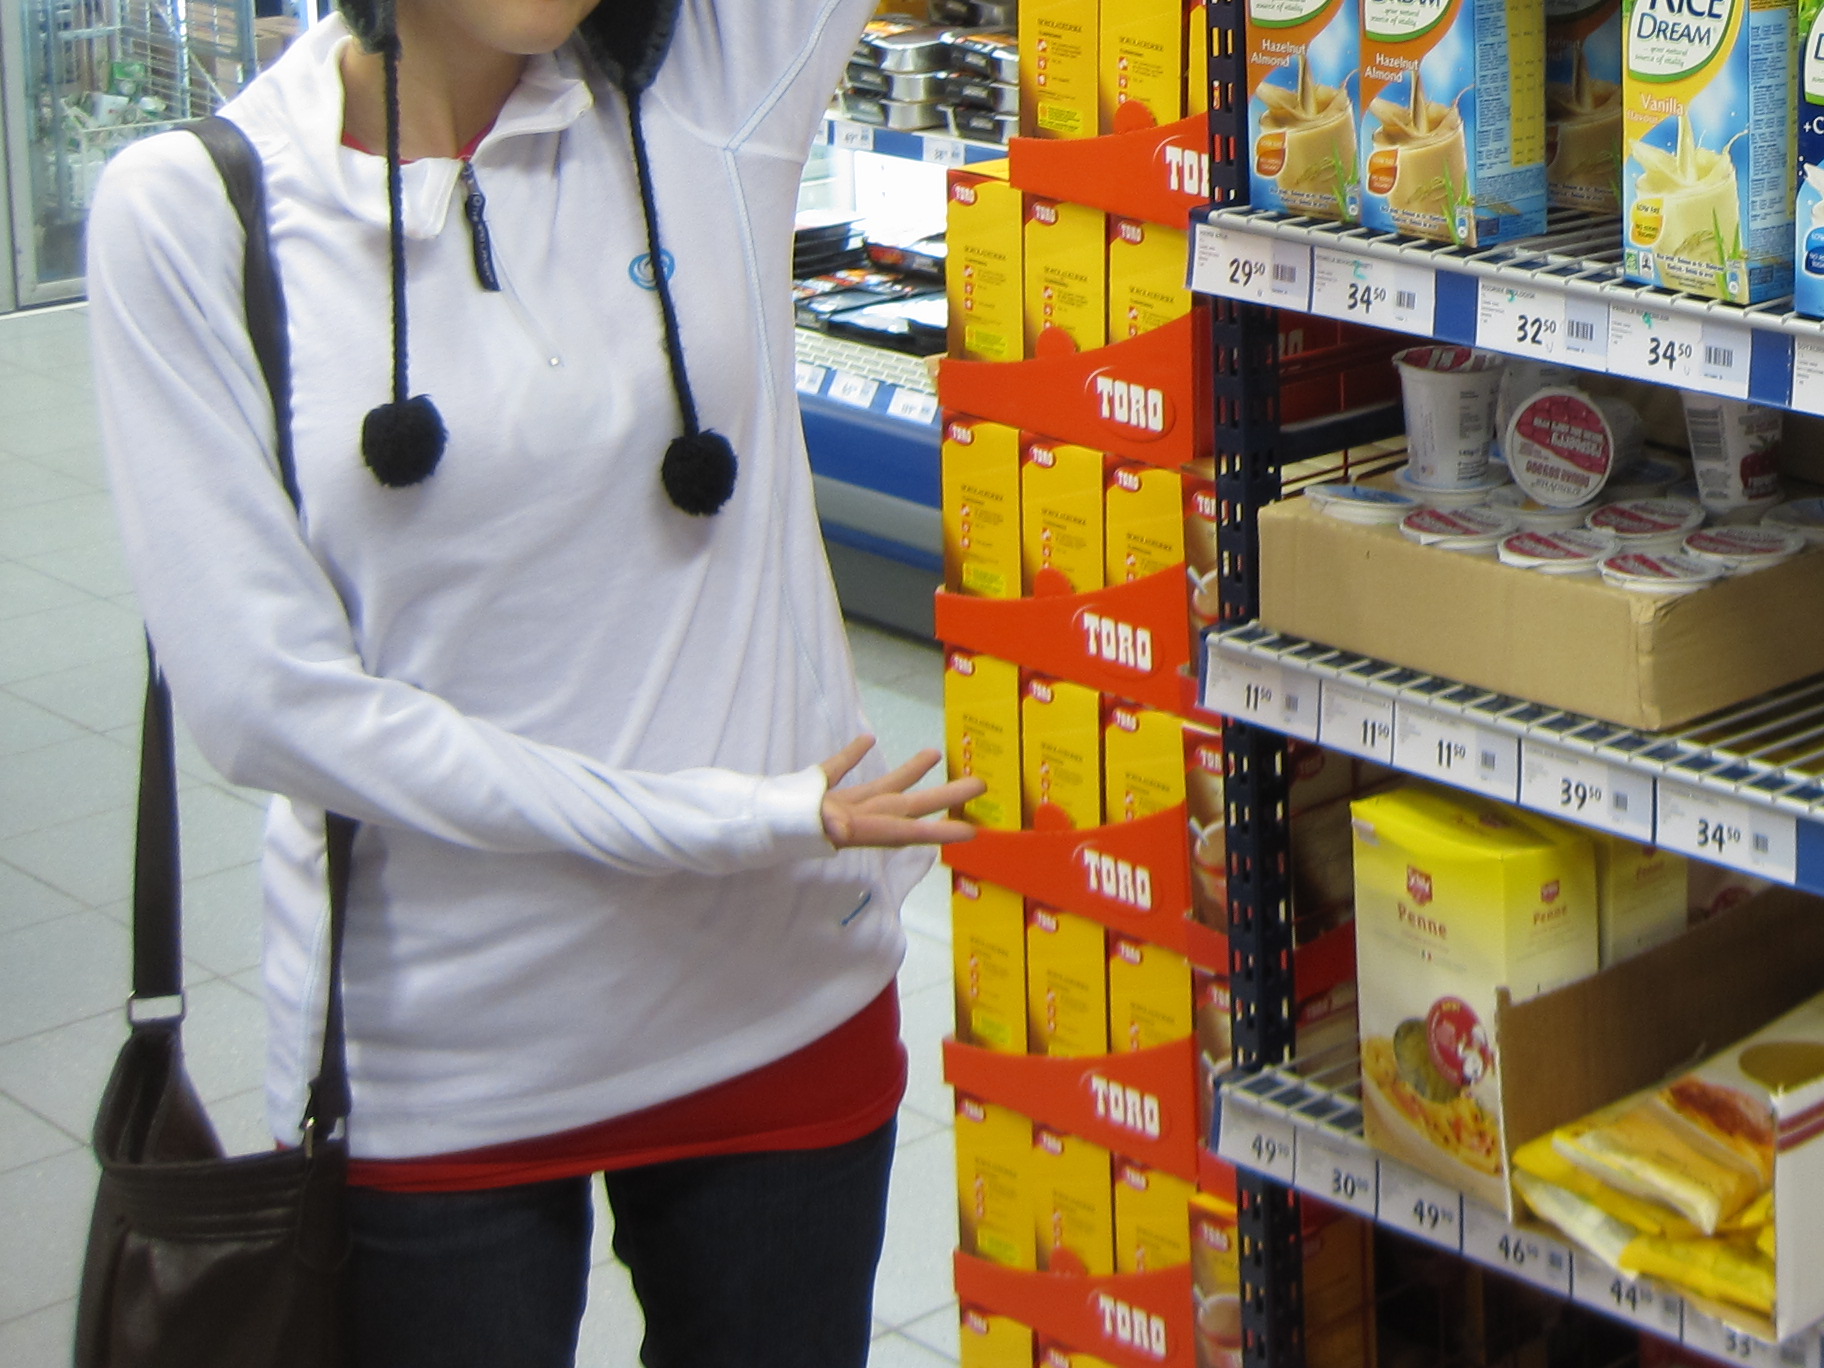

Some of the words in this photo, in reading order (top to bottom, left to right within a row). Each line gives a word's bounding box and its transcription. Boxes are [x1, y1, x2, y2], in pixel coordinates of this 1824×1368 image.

[1636, 12, 1713, 46] DREAM
[1251, 53, 1290, 68] Almond
[1262, 38, 1307, 56] Hazelnut
[1375, 53, 1419, 72] Hazelnut
[1364, 66, 1403, 83] Almond
[1640, 93, 1685, 116] Vanilla
[1096, 376, 1164, 433] TORO
[1082, 610, 1153, 671] TORO
[1083, 847, 1153, 911] TORO
[1091, 1075, 1161, 1137] TORO
[1099, 1293, 1168, 1359] TORO
